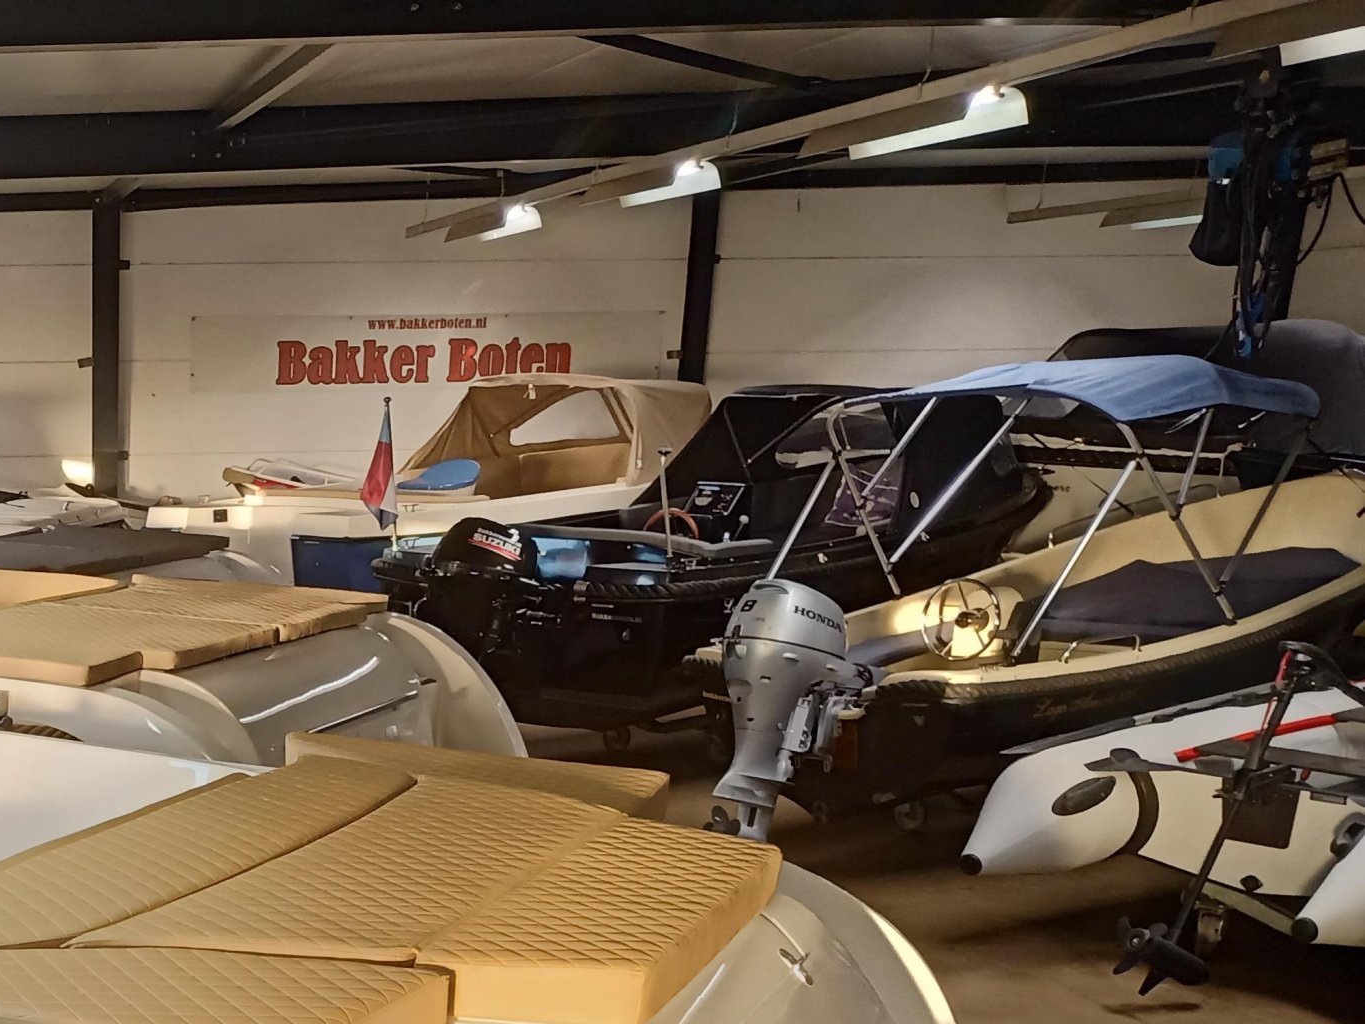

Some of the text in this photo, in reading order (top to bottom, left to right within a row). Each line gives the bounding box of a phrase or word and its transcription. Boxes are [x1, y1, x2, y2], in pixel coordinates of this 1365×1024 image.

[368, 317, 486, 330] www.bakkerboten.nl
[276, 337, 572, 385] Bakker Boten
[473, 532, 521, 556] SUZUKI
[793, 605, 843, 633] HONDA
